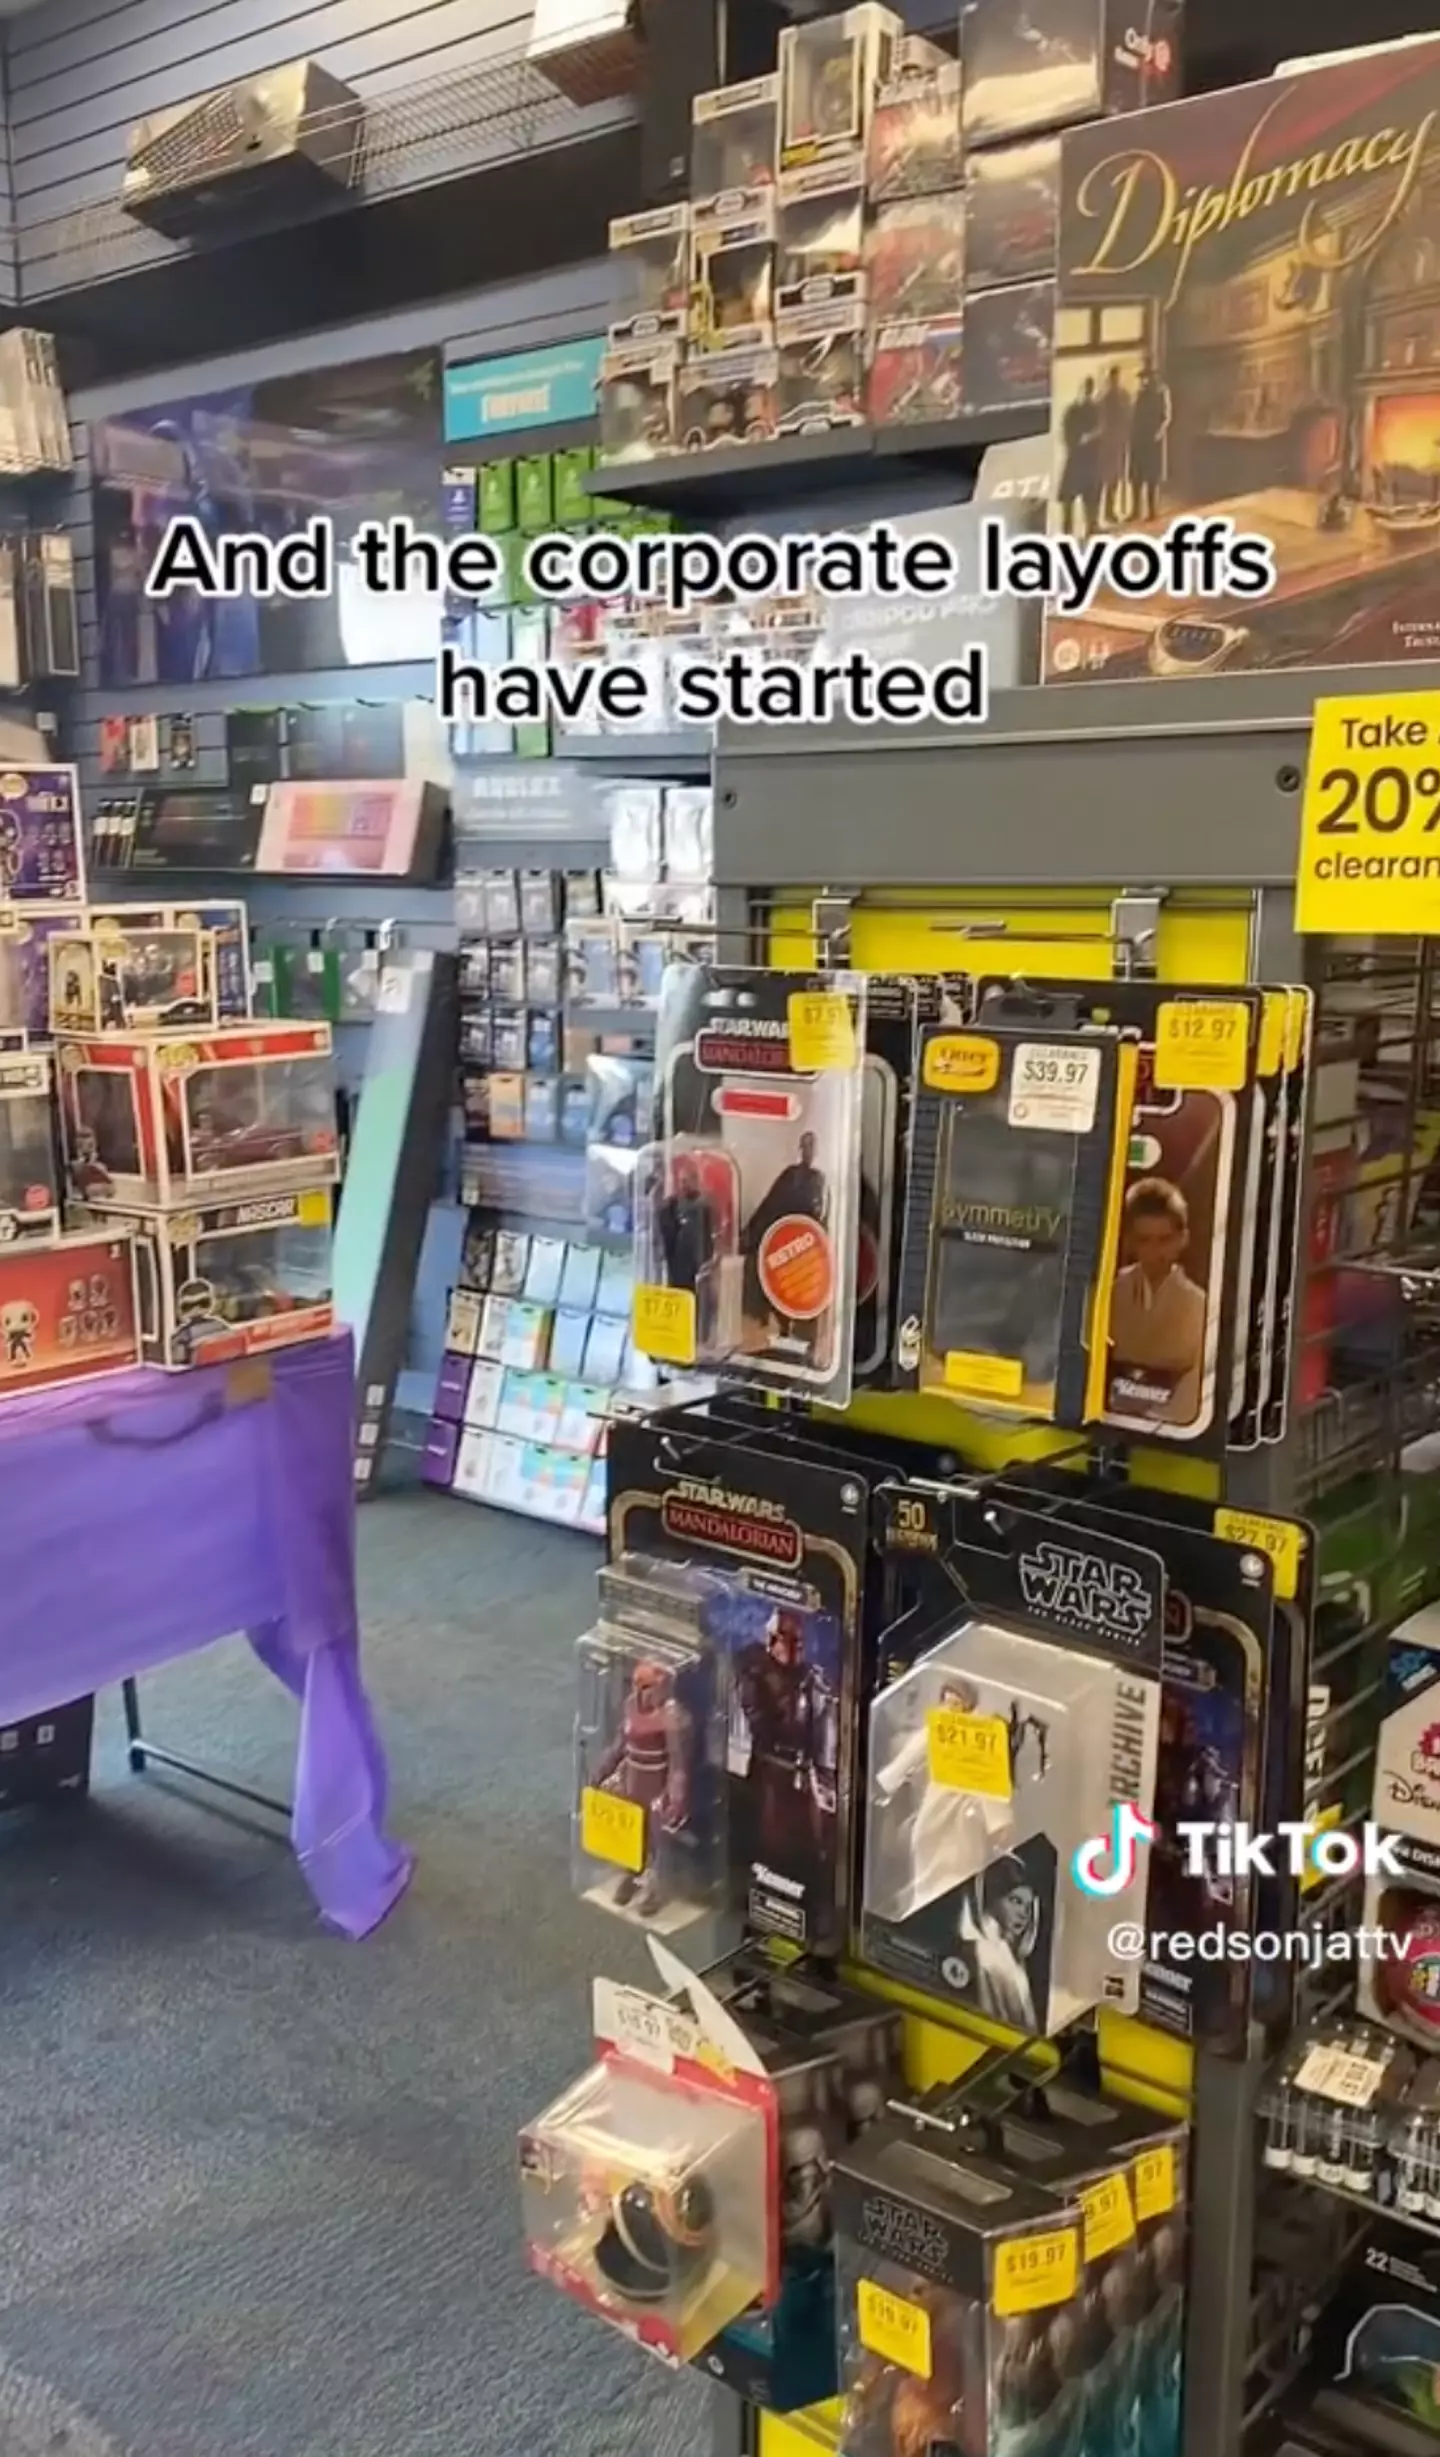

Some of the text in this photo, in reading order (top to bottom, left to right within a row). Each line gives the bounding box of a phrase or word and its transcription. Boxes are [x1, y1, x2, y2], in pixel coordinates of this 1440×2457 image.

[1070, 83, 1437, 311] Diplomacy
[1341, 715, 1428, 749] Take
[1168, 1018, 1237, 1040] $12.97
[1023, 1059, 1090, 1084] $39.97
[677, 1480, 787, 1522] STAR WARS
[898, 1500, 926, 1530] 50
[668, 1508, 794, 1558] MANDALORIAN
[1020, 1542, 1151, 1600] STAR
[1022, 1569, 1151, 1634] WARS
[937, 1723, 998, 1754] $21.97
[1108, 1682, 1147, 1804] RCHIVE
[1005, 2242, 1067, 2274] $19.97
[1366, 2247, 1389, 2273] 22
